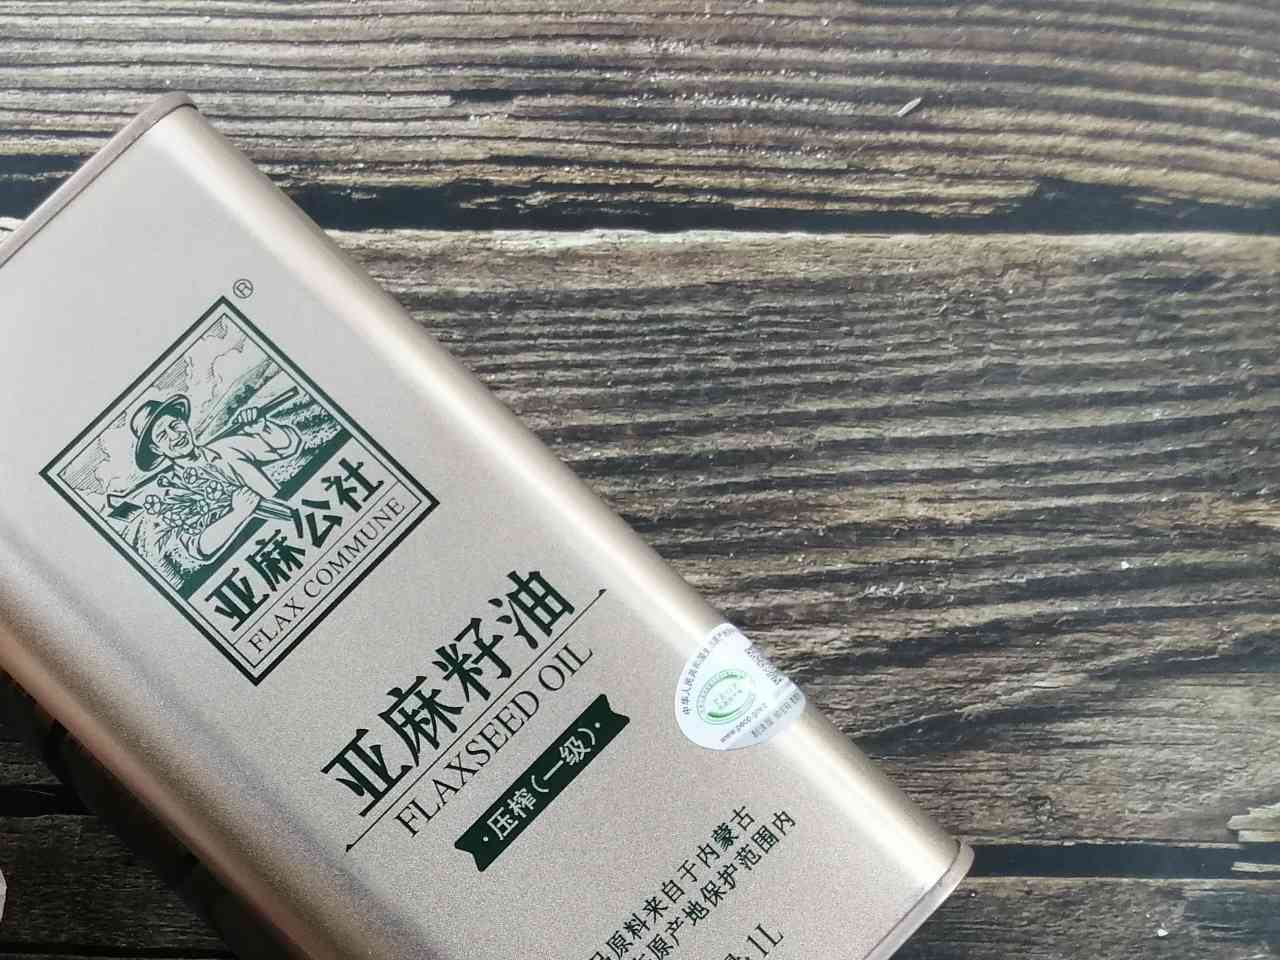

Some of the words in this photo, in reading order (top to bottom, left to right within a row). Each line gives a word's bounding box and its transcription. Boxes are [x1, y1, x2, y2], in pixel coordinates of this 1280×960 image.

[205, 456, 385, 632] 亚麻公社
[248, 598, 306, 655] FLAX
[303, 498, 407, 600] COMMUNE
[320, 570, 575, 818] 亚麻籽油
[394, 690, 540, 837] FLAXSEED
[538, 643, 593, 692] OIL
